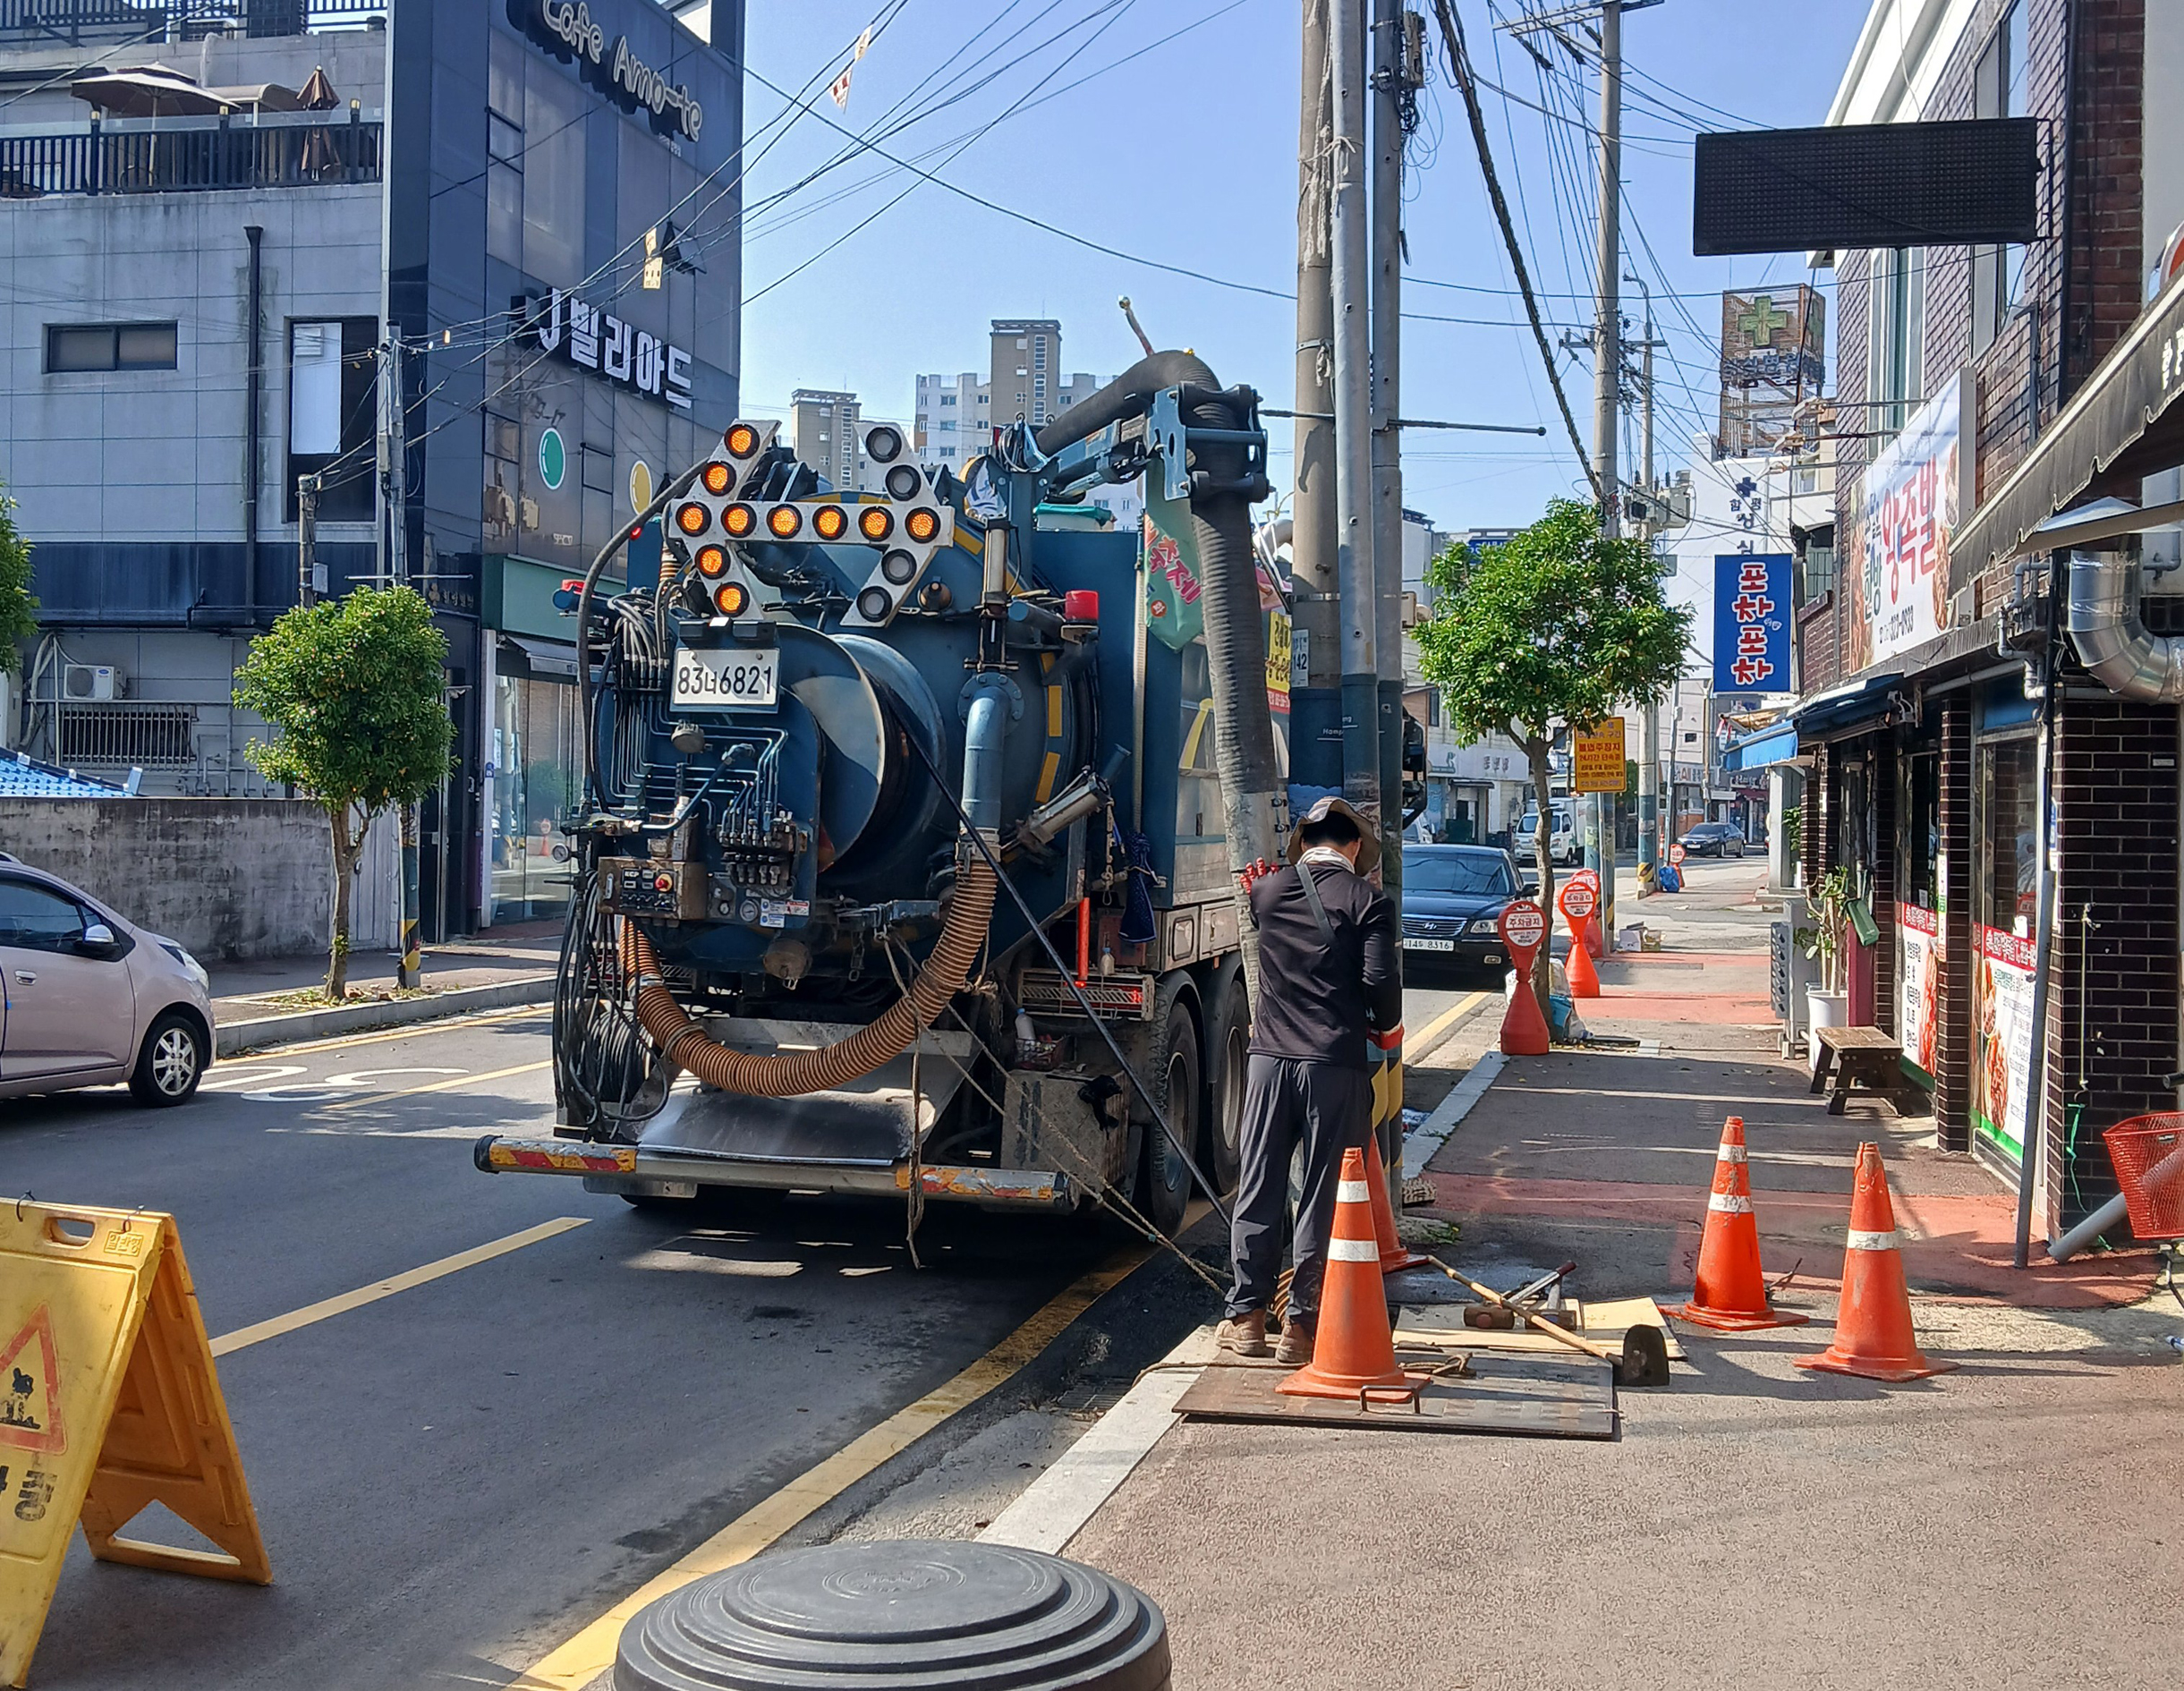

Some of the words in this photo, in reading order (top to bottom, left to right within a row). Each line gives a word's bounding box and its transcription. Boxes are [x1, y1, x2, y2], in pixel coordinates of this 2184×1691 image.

[542, 0, 604, 64] Cafe
[1882, 453, 1940, 606] 왕족발
[1730, 561, 1776, 687] 포차포차
[1508, 917, 1541, 928] 주차금지
